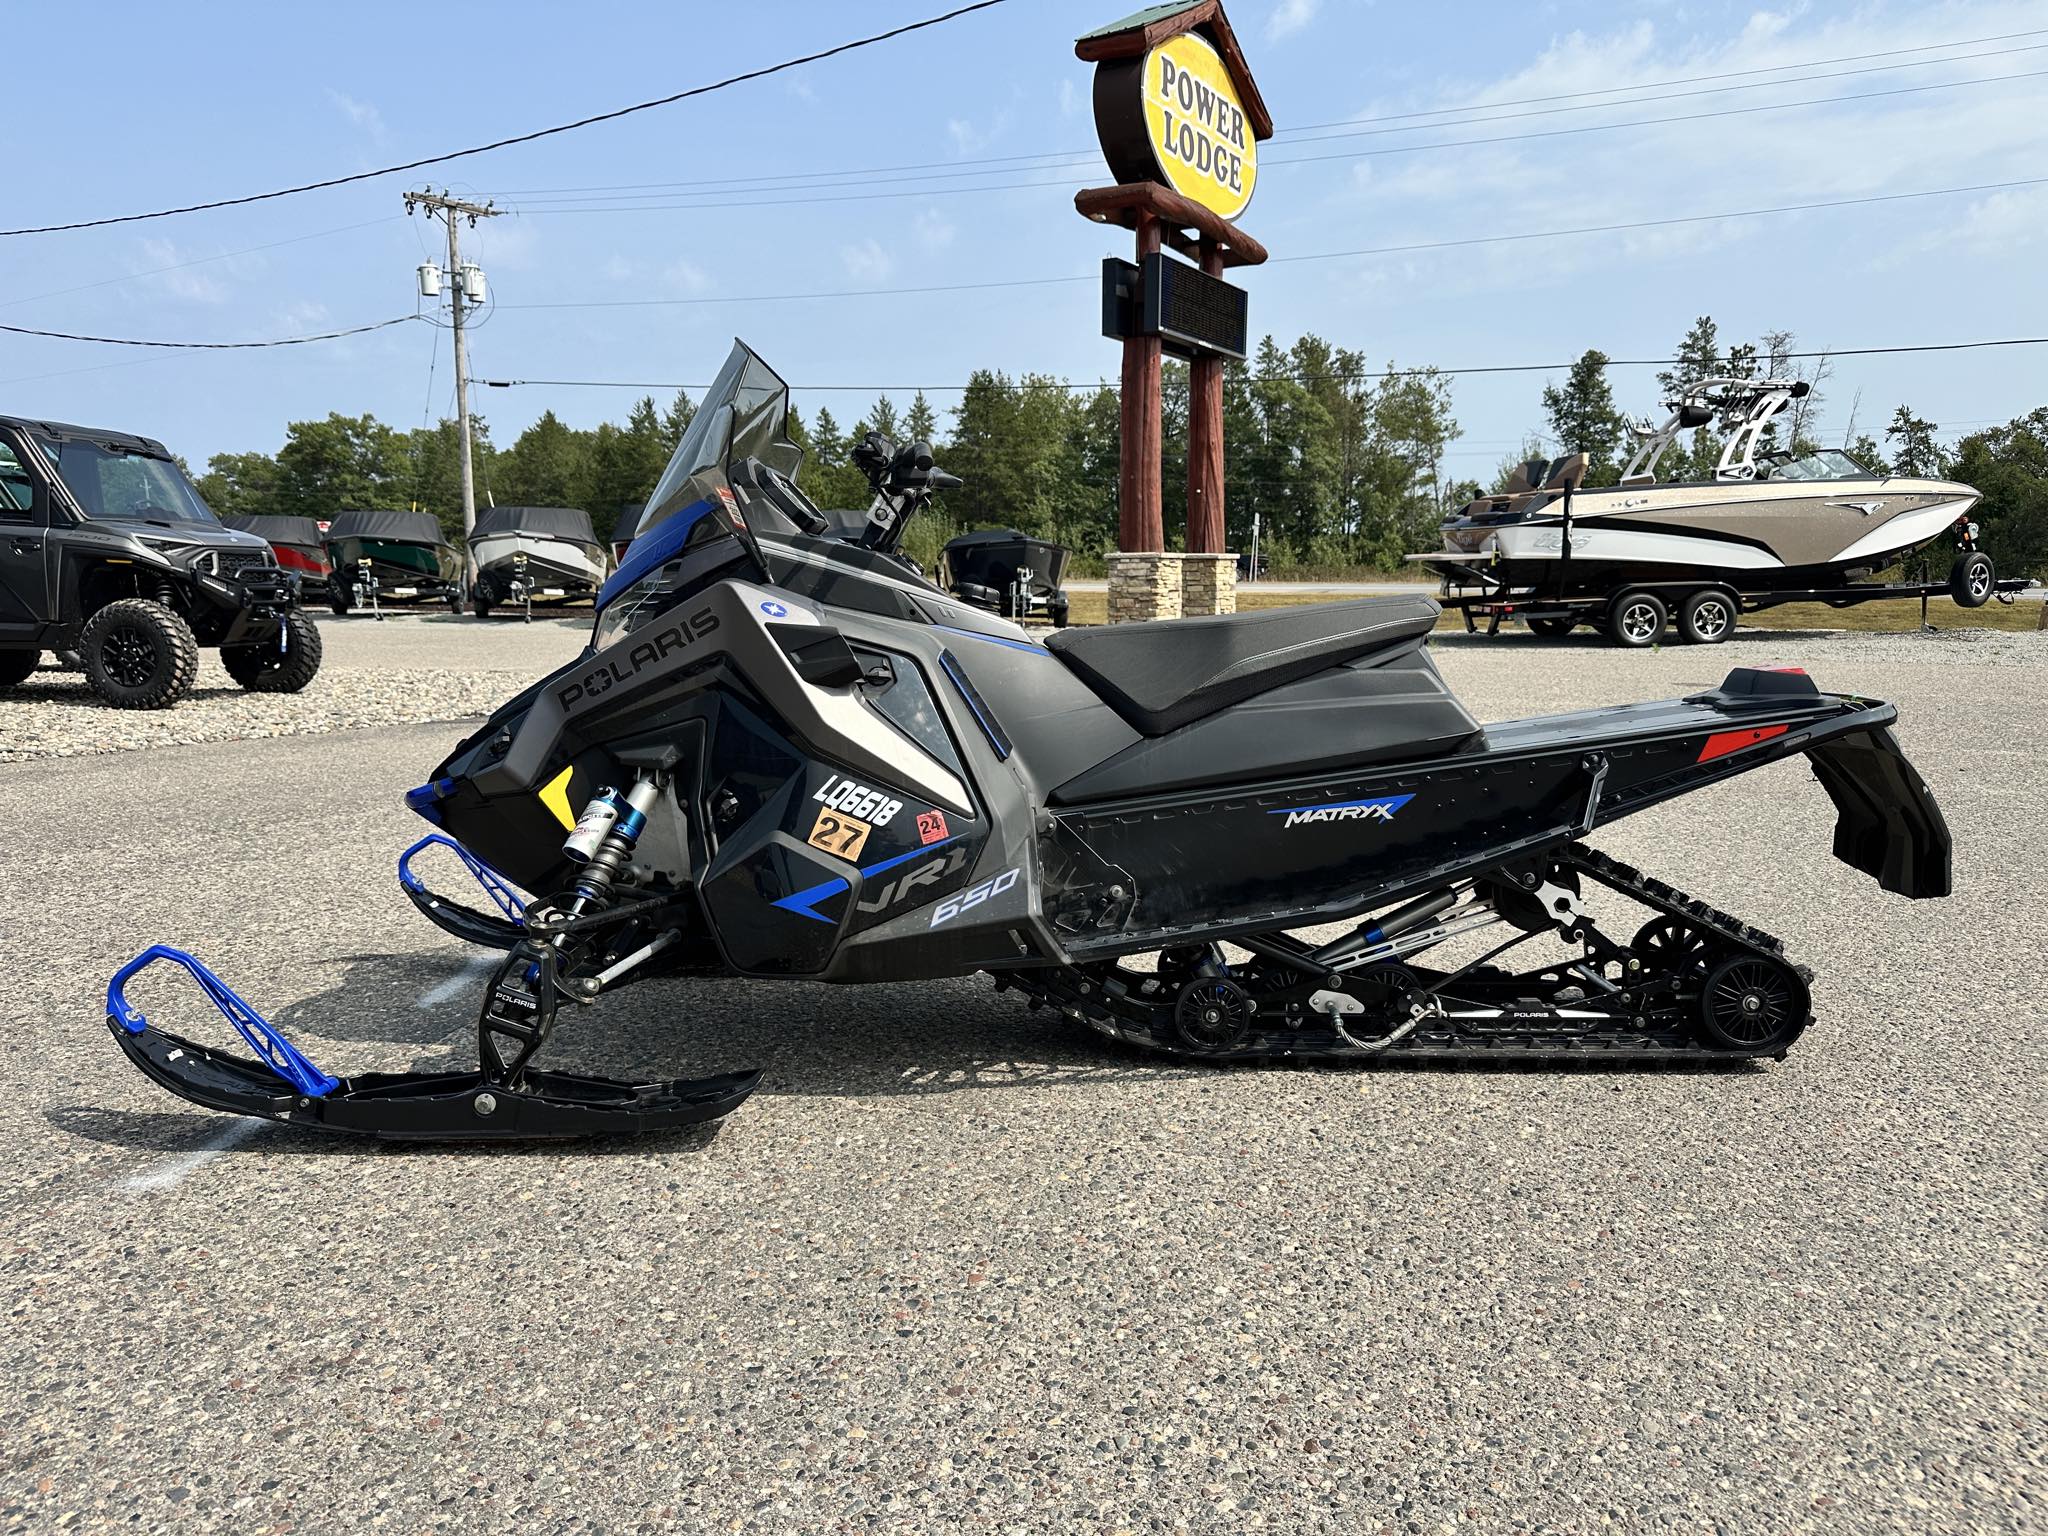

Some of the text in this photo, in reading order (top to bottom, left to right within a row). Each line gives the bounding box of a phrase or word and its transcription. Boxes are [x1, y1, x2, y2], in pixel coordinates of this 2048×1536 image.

[1161, 55, 1245, 150] POWER
[1163, 110, 1242, 194] LODGE
[557, 606, 720, 712] POLARIS
[812, 816, 864, 854] 27
[919, 817, 941, 835] 24
[1284, 803, 1394, 828] MATRYX
[929, 868, 1020, 928] 650
[495, 992, 536, 1009] POLARIS
